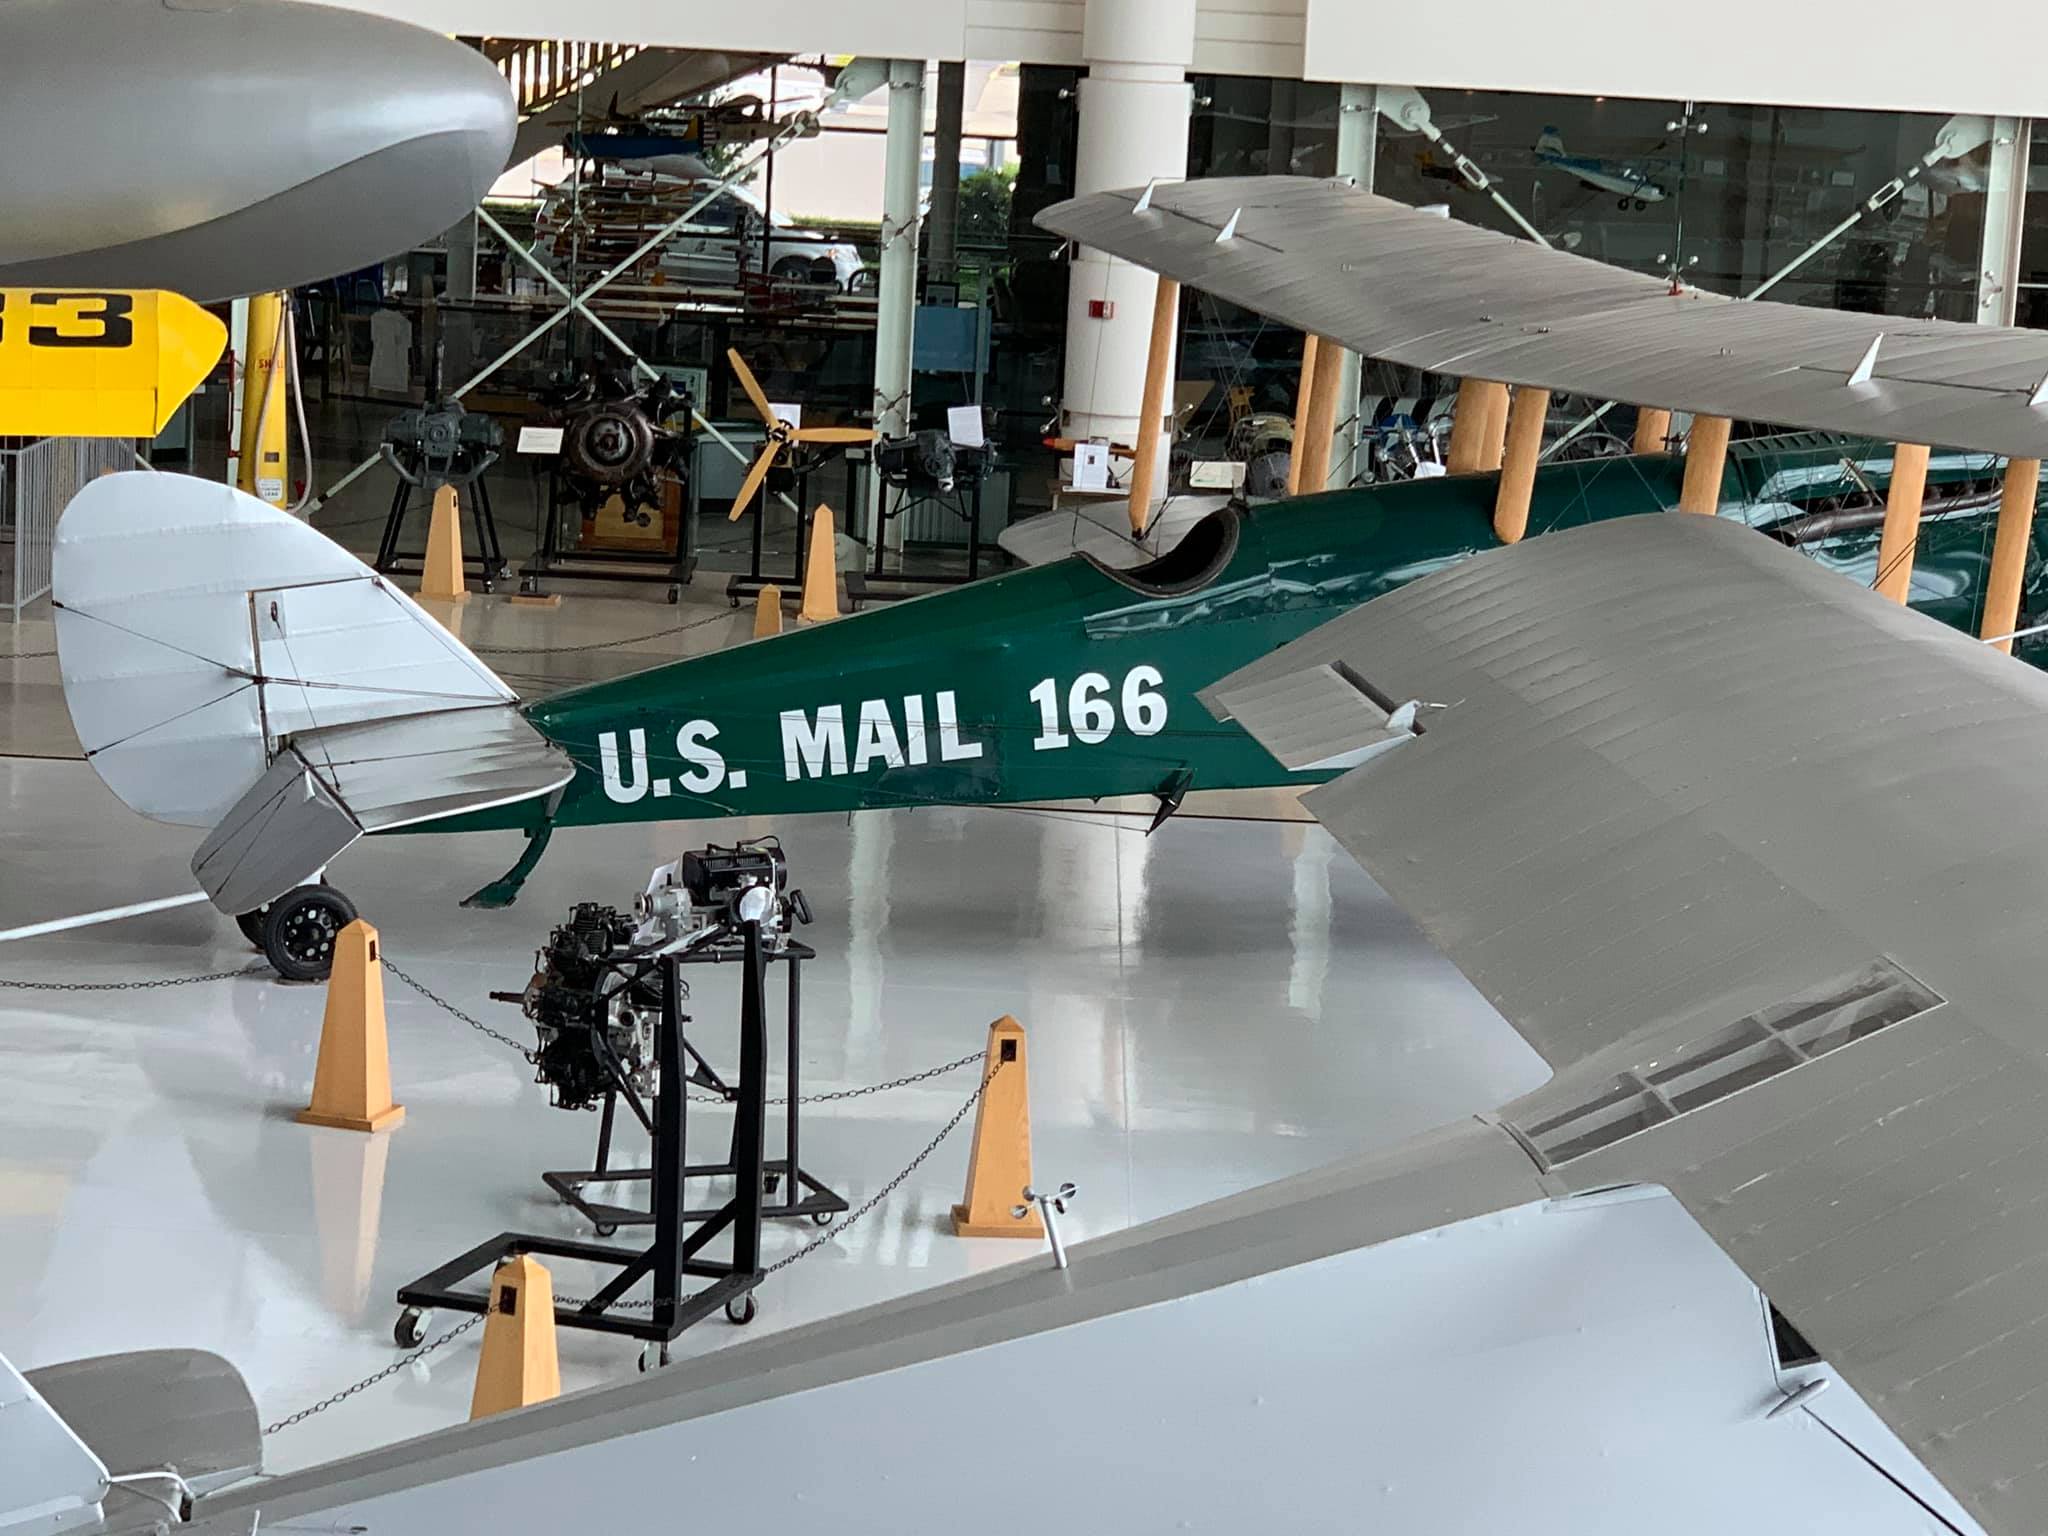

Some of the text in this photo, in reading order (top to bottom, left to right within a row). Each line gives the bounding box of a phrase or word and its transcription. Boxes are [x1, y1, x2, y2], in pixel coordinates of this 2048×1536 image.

[0, 293, 133, 347] 3
[599, 665, 1168, 803] U.S. MAIL 166
